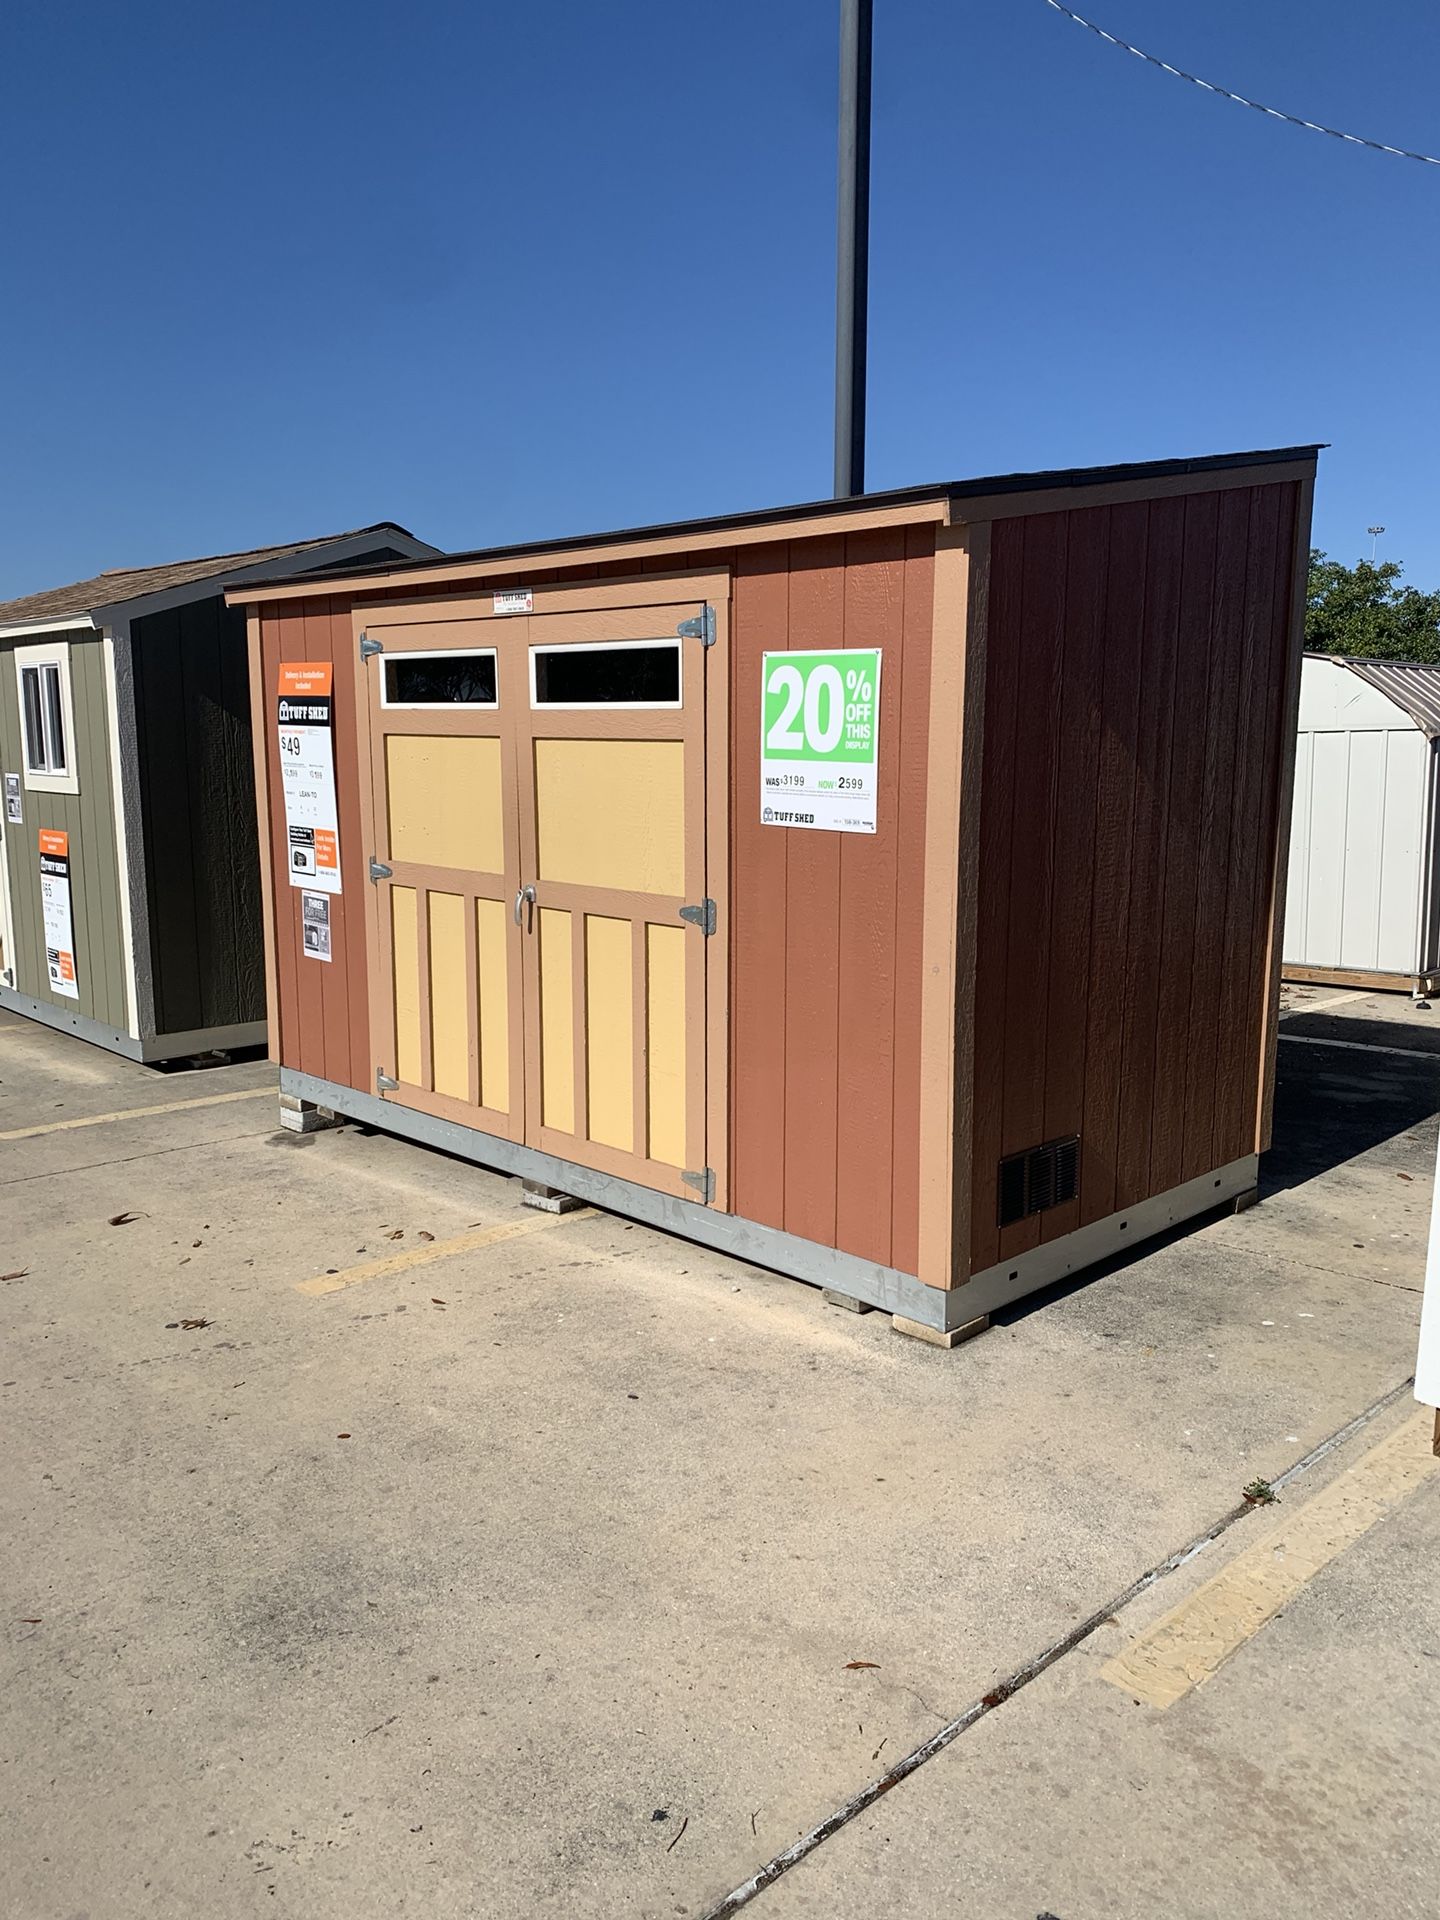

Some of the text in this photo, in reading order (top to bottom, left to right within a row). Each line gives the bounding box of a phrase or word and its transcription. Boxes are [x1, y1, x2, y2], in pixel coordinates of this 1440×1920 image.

[289, 705, 328, 720] TUFF SHED
[845, 703, 872, 722] OFF
[845, 723, 871, 739] THIS
[845, 740, 871, 750] DISPLAY
[774, 811, 815, 824] TUFF SHED
[308, 898, 324, 910] THREE
